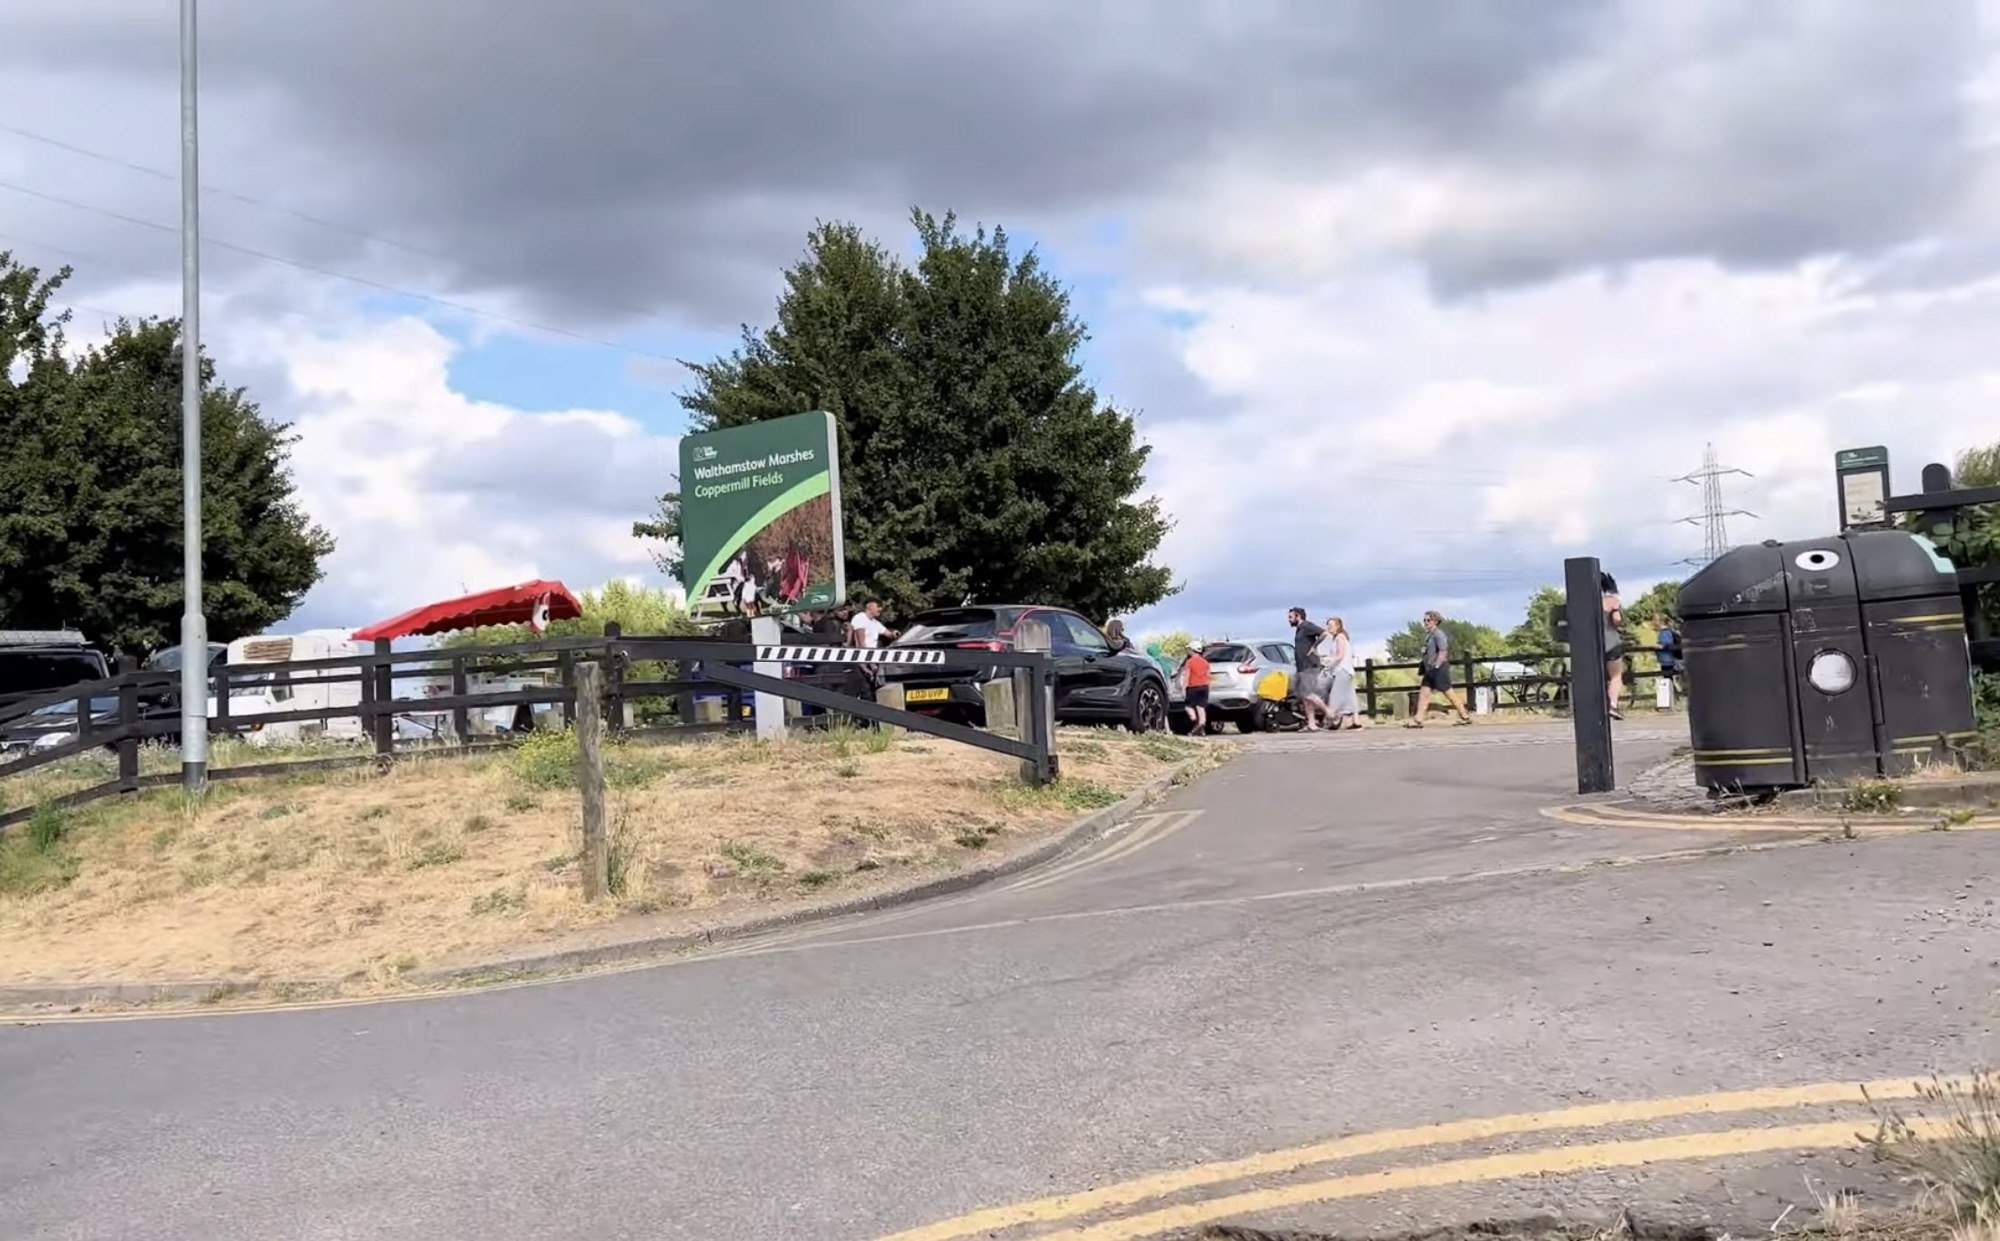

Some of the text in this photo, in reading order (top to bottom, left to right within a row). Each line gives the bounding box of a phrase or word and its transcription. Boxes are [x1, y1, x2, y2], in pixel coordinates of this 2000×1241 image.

[694, 449, 814, 480] Walthamstow Marshes
[695, 472, 783, 499] Coppermill Fields
